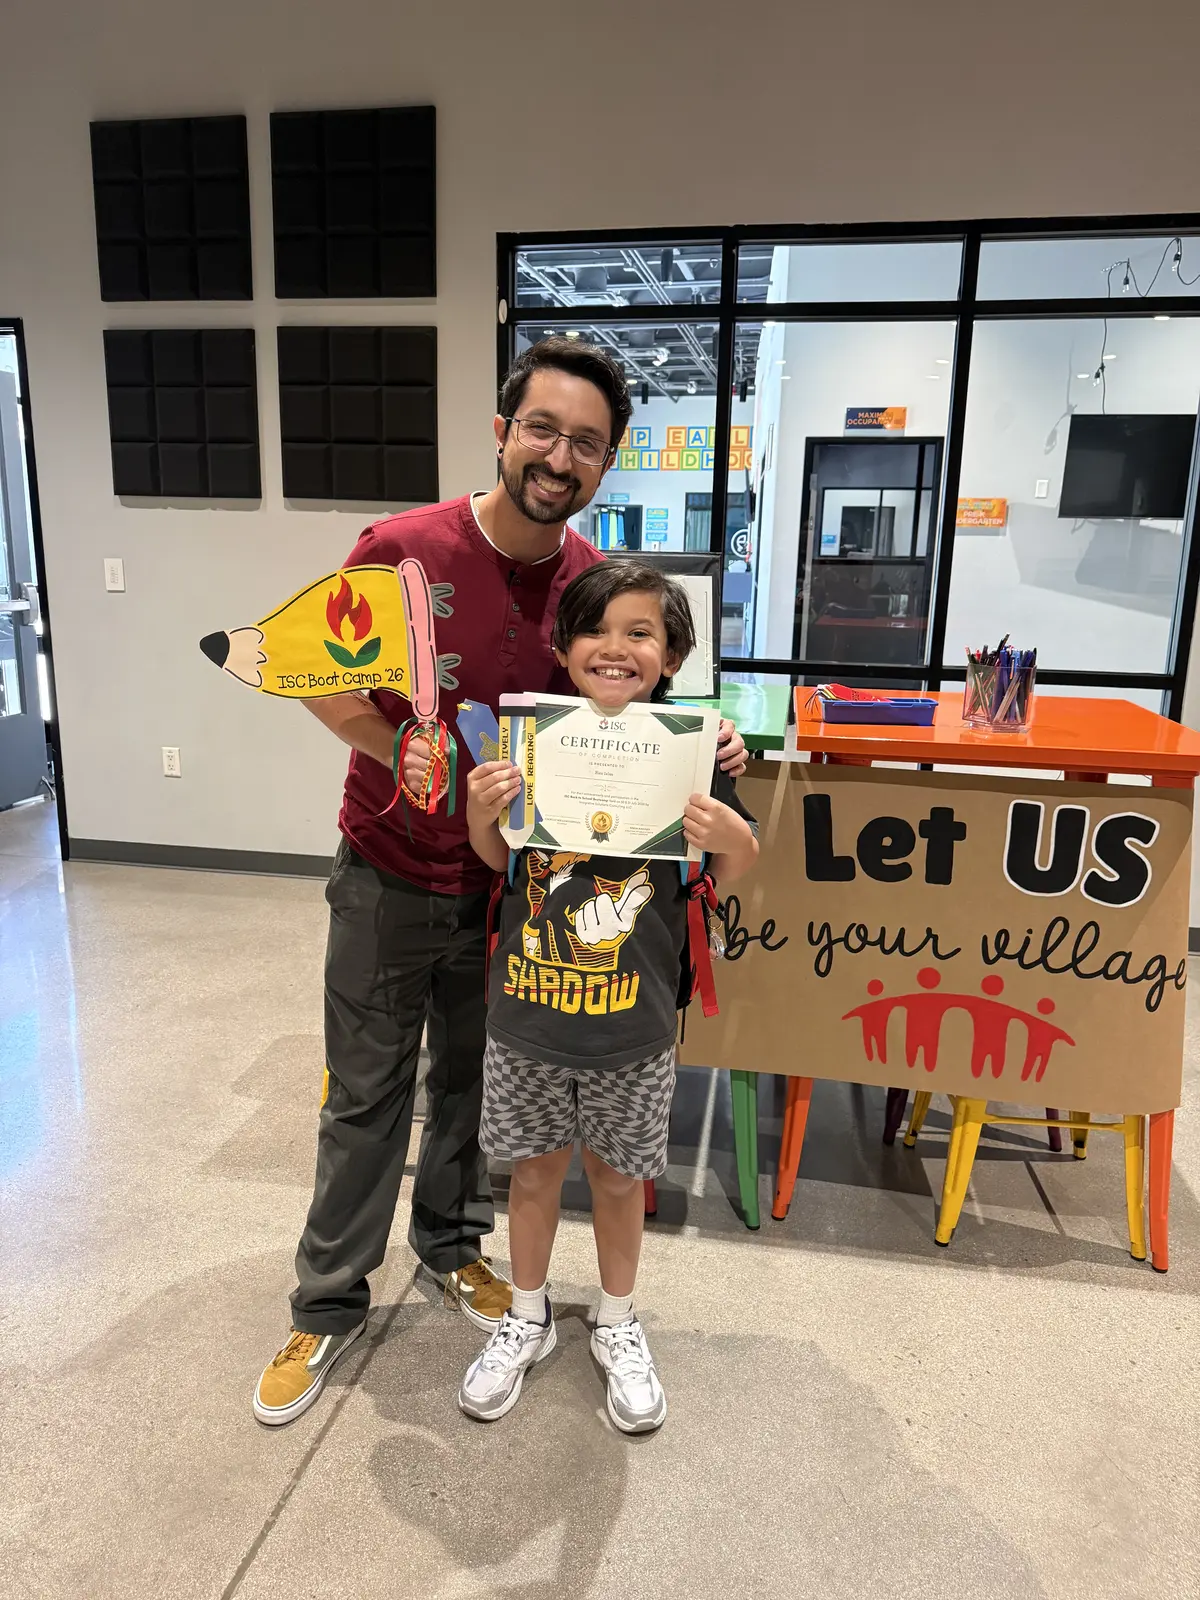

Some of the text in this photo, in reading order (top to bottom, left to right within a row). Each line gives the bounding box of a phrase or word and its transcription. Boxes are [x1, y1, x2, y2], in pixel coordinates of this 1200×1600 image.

[277, 675, 306, 689] ISC
[308, 671, 340, 688] Boot
[342, 672, 382, 687] Camp
[560, 735, 661, 755] CERTIFICATE
[610, 721, 626, 731] ISC
[526, 732, 534, 806] LOVE READING!
[592, 753, 640, 762] COMPLETION
[803, 794, 1160, 908] Let US
[724, 895, 1188, 1012] be your village
[503, 953, 640, 1015] SHADOW
